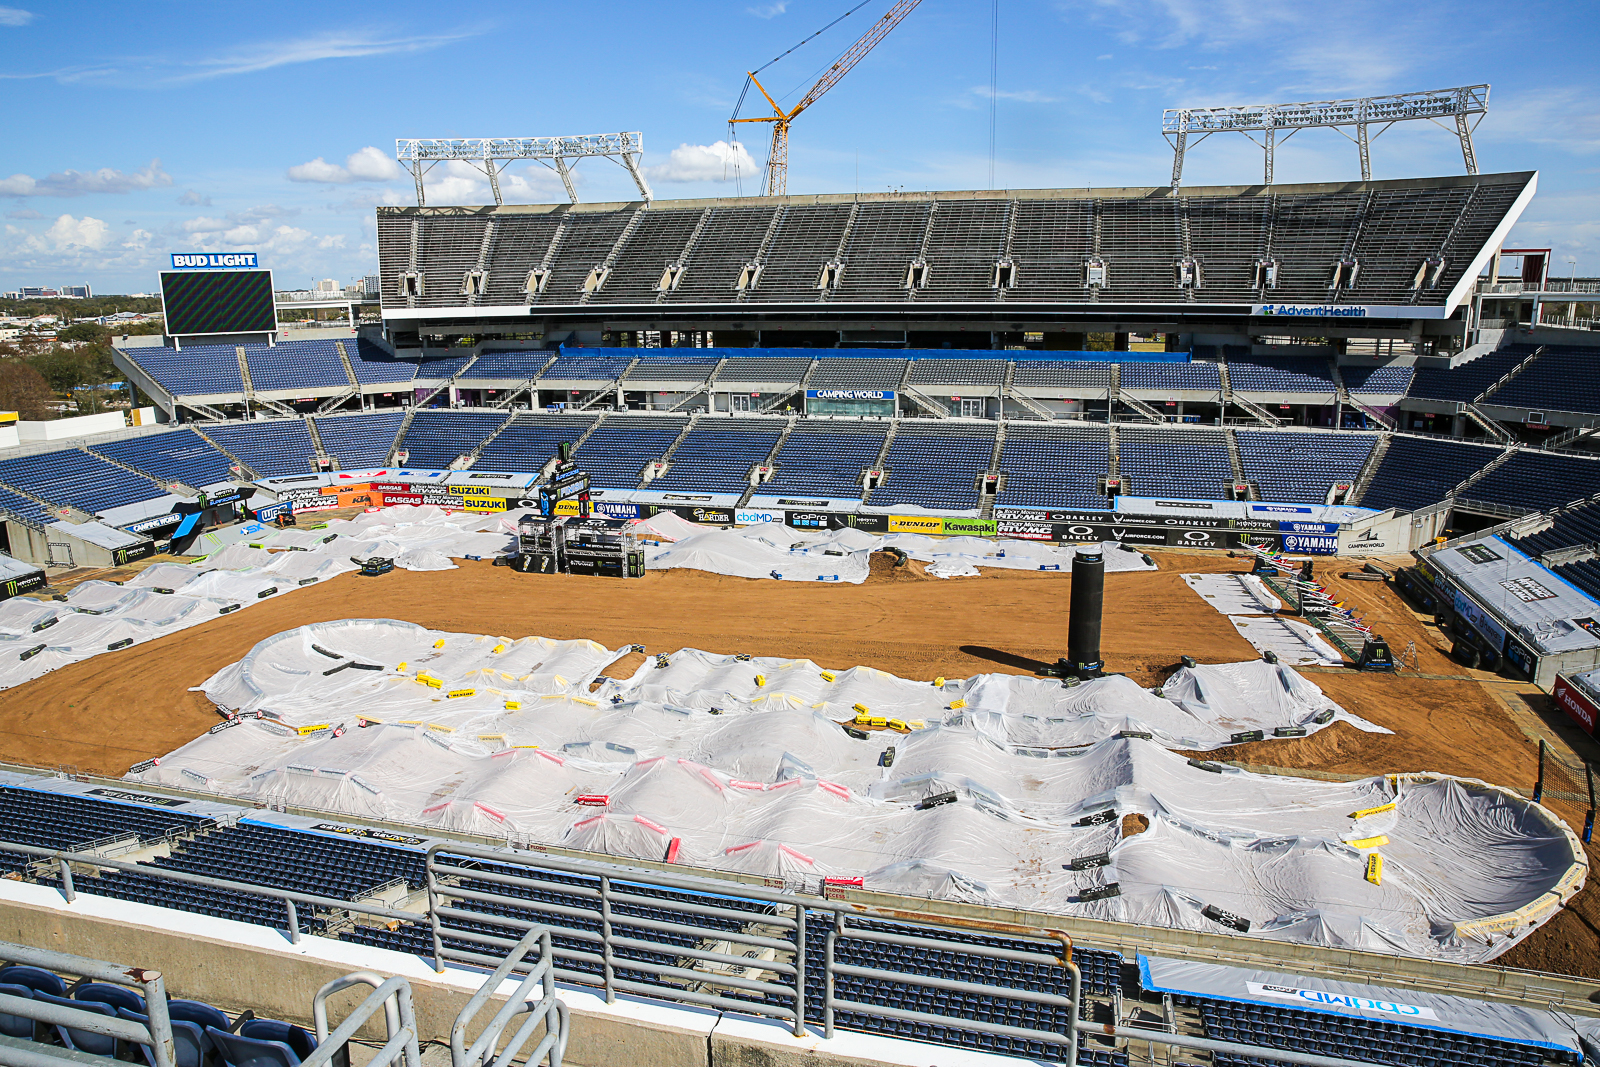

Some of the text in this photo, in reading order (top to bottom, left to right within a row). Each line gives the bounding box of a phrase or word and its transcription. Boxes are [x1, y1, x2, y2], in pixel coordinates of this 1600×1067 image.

[173, 254, 256, 267] BUD LIGHT
[1278, 305, 1366, 317] AdventHealth
[816, 390, 884, 399] CAMPING WORLD
[450, 486, 490, 495] SUZUKI
[560, 480, 584, 498] FINISH
[384, 496, 422, 504] GASGAS
[465, 499, 507, 509] SUZUKI
[605, 503, 637, 514] YAMAHA
[698, 513, 730, 522] HARDER
[736, 512, 772, 523] cbdMD
[792, 513, 828, 521] GoPro
[133, 514, 181, 532] CAMPING WORLD
[898, 520, 940, 528] DUNLOP
[944, 522, 995, 533] Kawasaki
[1178, 519, 1218, 527] OAKLEY
[1300, 523, 1326, 532] YAMAHA
[1298, 536, 1338, 549] YAMAHA
[1508, 640, 1532, 665] GoPro
[1564, 693, 1593, 727] HONDA
